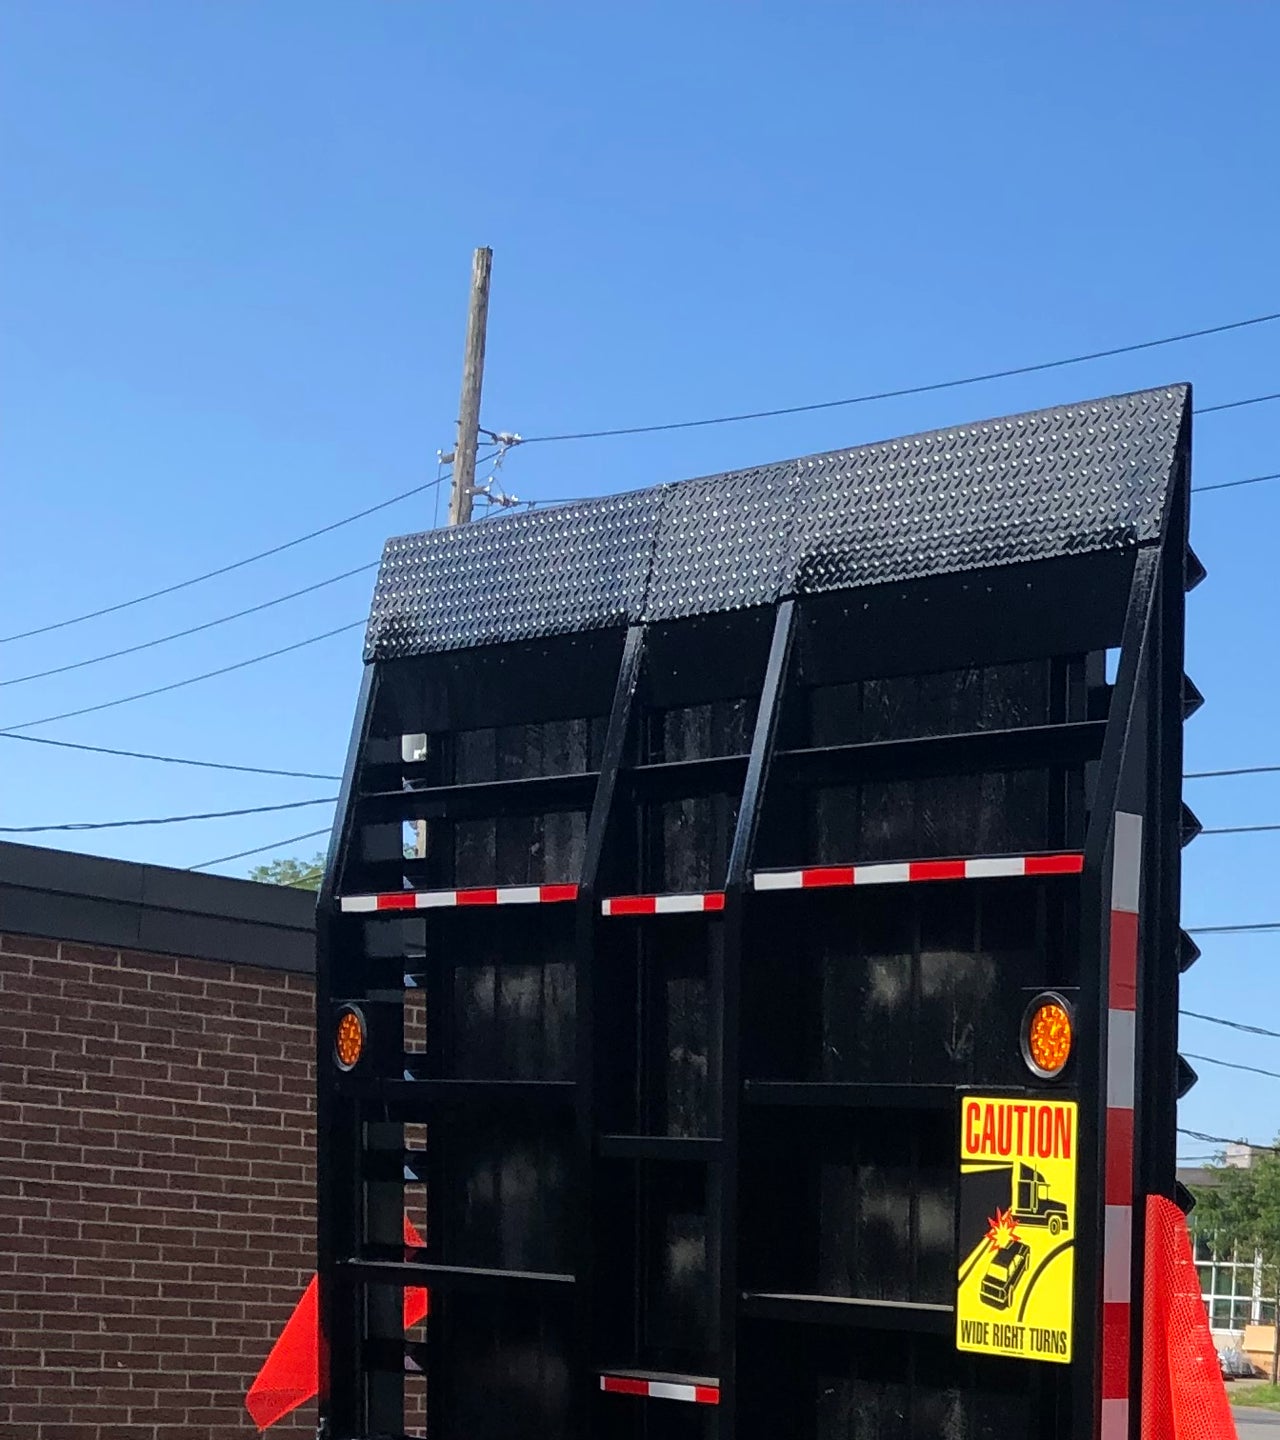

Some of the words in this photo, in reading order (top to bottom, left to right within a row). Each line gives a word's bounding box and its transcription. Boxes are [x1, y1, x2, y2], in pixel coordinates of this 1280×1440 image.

[966, 1101, 1072, 1160] CAUTION
[960, 1319, 990, 1346] WIDE
[992, 1321, 1025, 1349] RIGHT
[1029, 1327, 1067, 1355] TURNS
